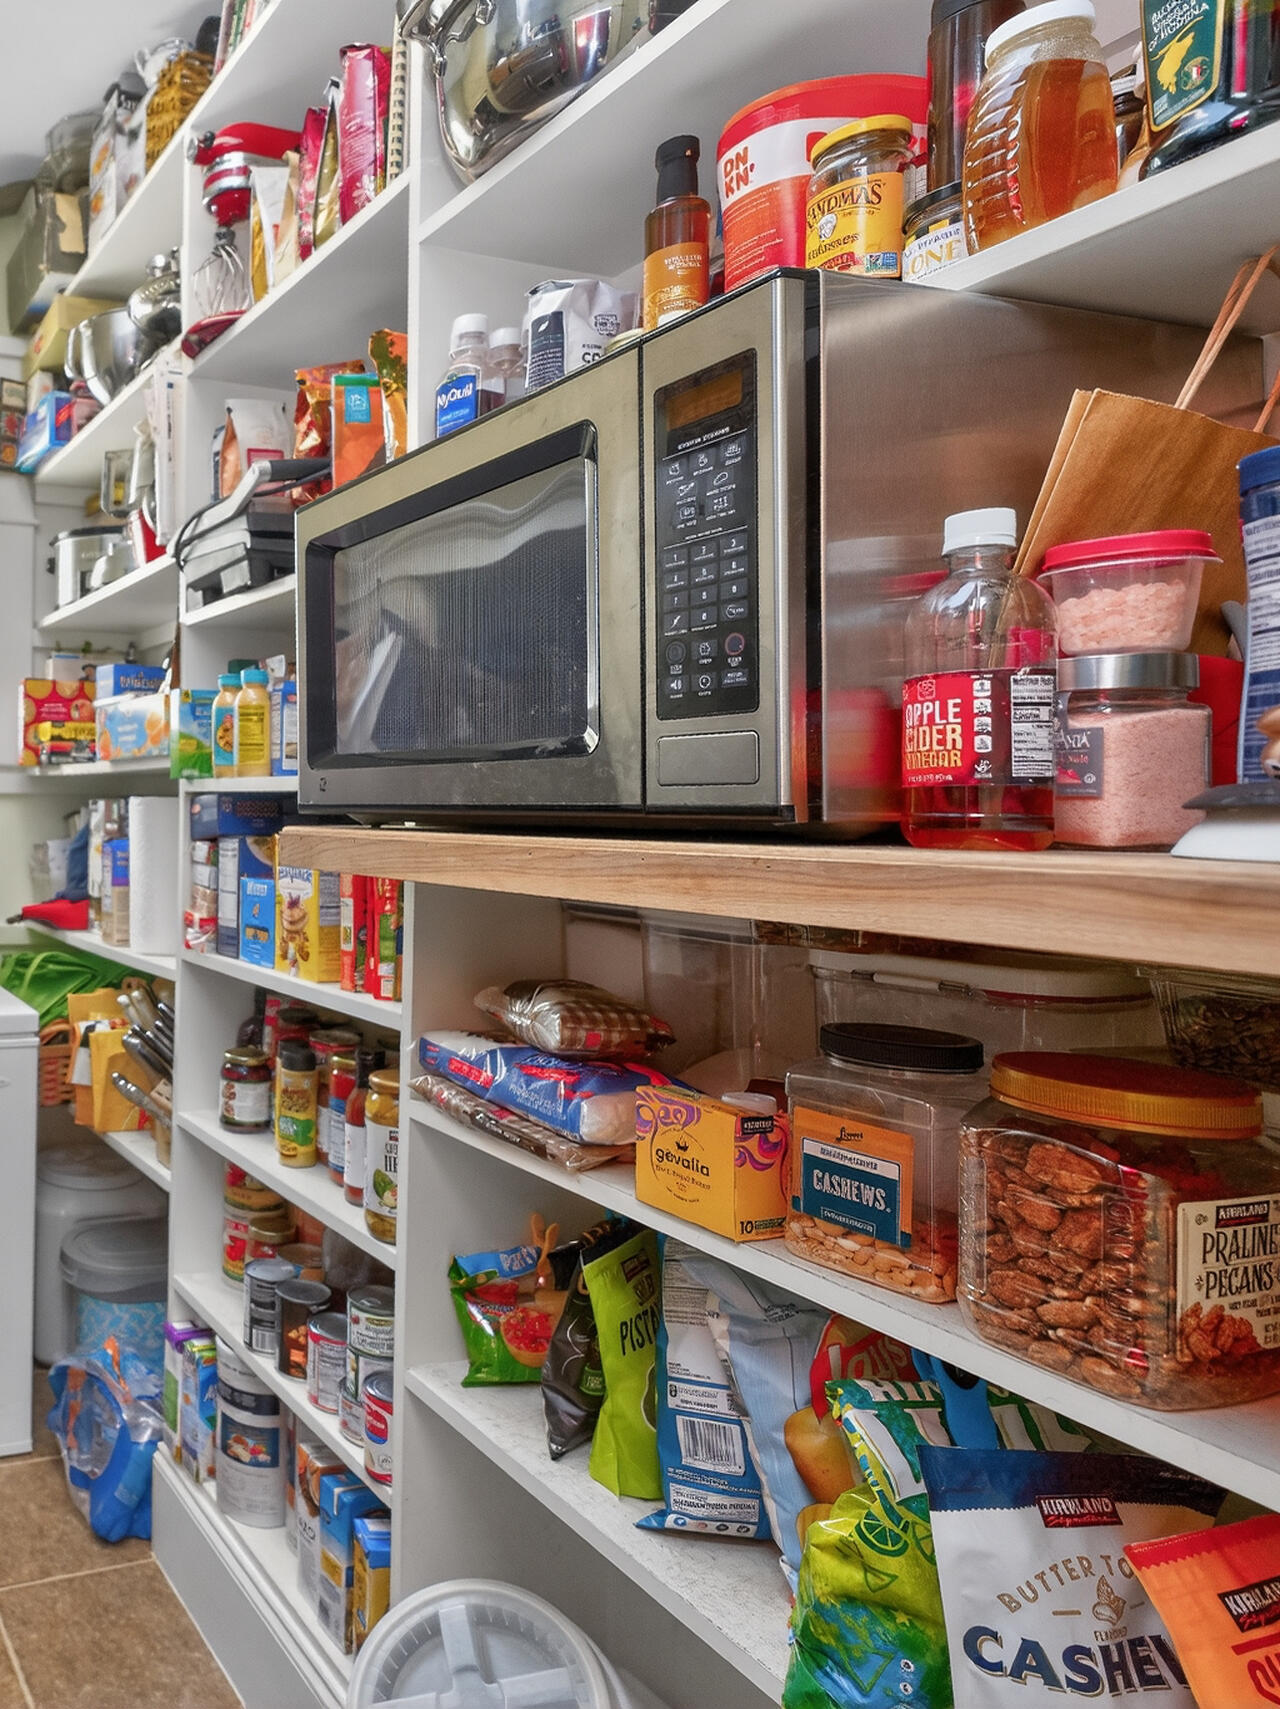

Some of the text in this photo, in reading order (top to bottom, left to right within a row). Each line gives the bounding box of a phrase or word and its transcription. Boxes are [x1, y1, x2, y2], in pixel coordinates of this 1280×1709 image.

[906, 698, 962, 727] APPLE
[905, 724, 963, 752] CIDER
[813, 1169, 886, 1211] CASHEWS
[739, 1219, 754, 1235] 10
[1205, 1261, 1274, 1299] PECANS
[996, 1554, 1137, 1614] BUTTER TO
